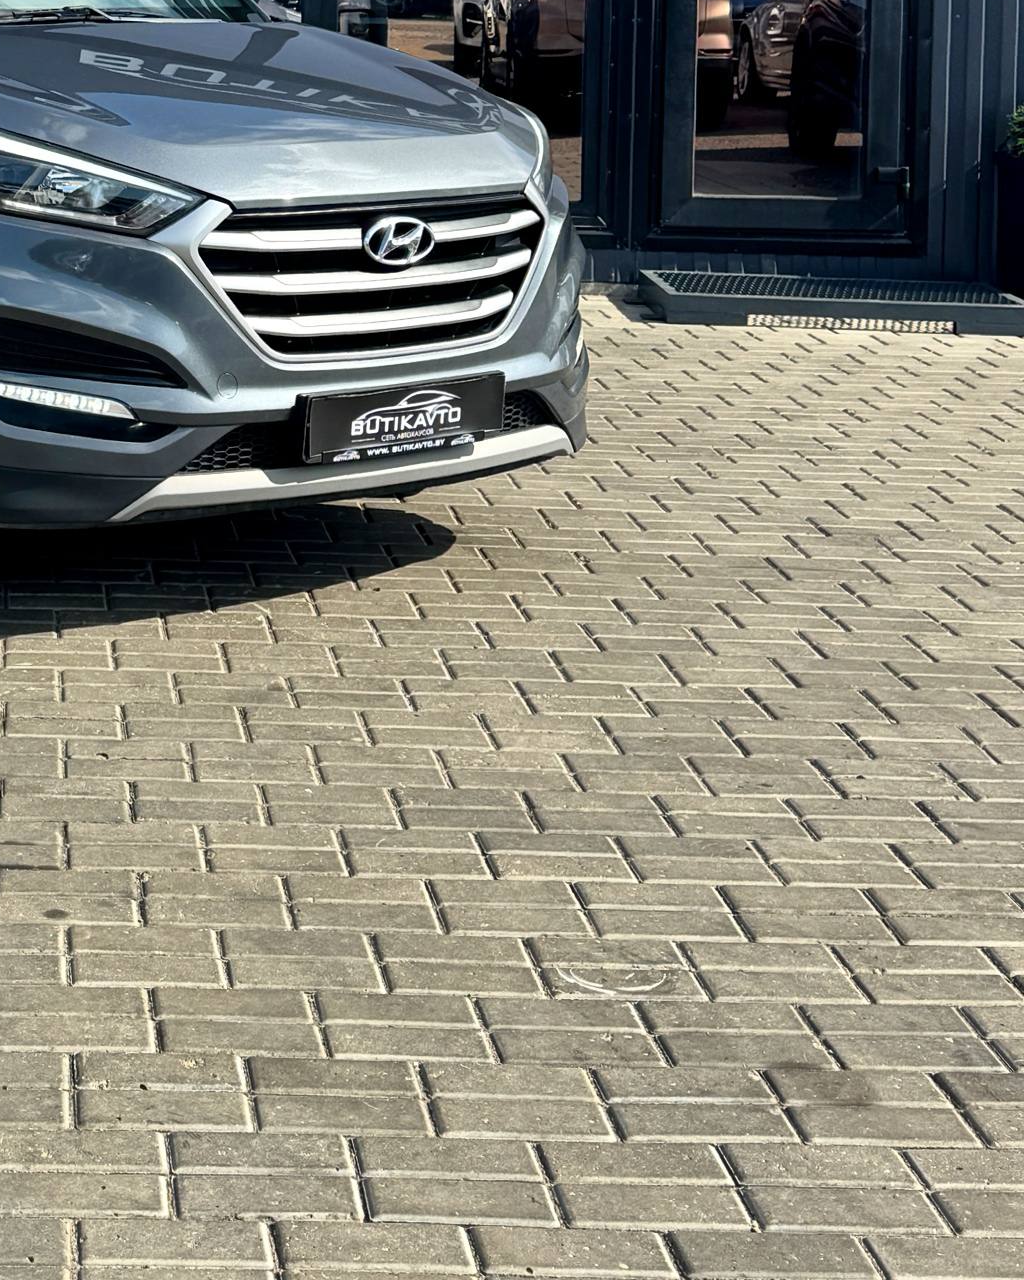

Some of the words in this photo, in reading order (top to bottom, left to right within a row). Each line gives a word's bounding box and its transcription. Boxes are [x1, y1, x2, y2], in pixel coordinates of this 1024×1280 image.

[350, 406, 461, 436] BUTIKAVTO
[367, 447, 390, 457] WWW.
[392, 438, 446, 454] BUTIKAVTO.BY
